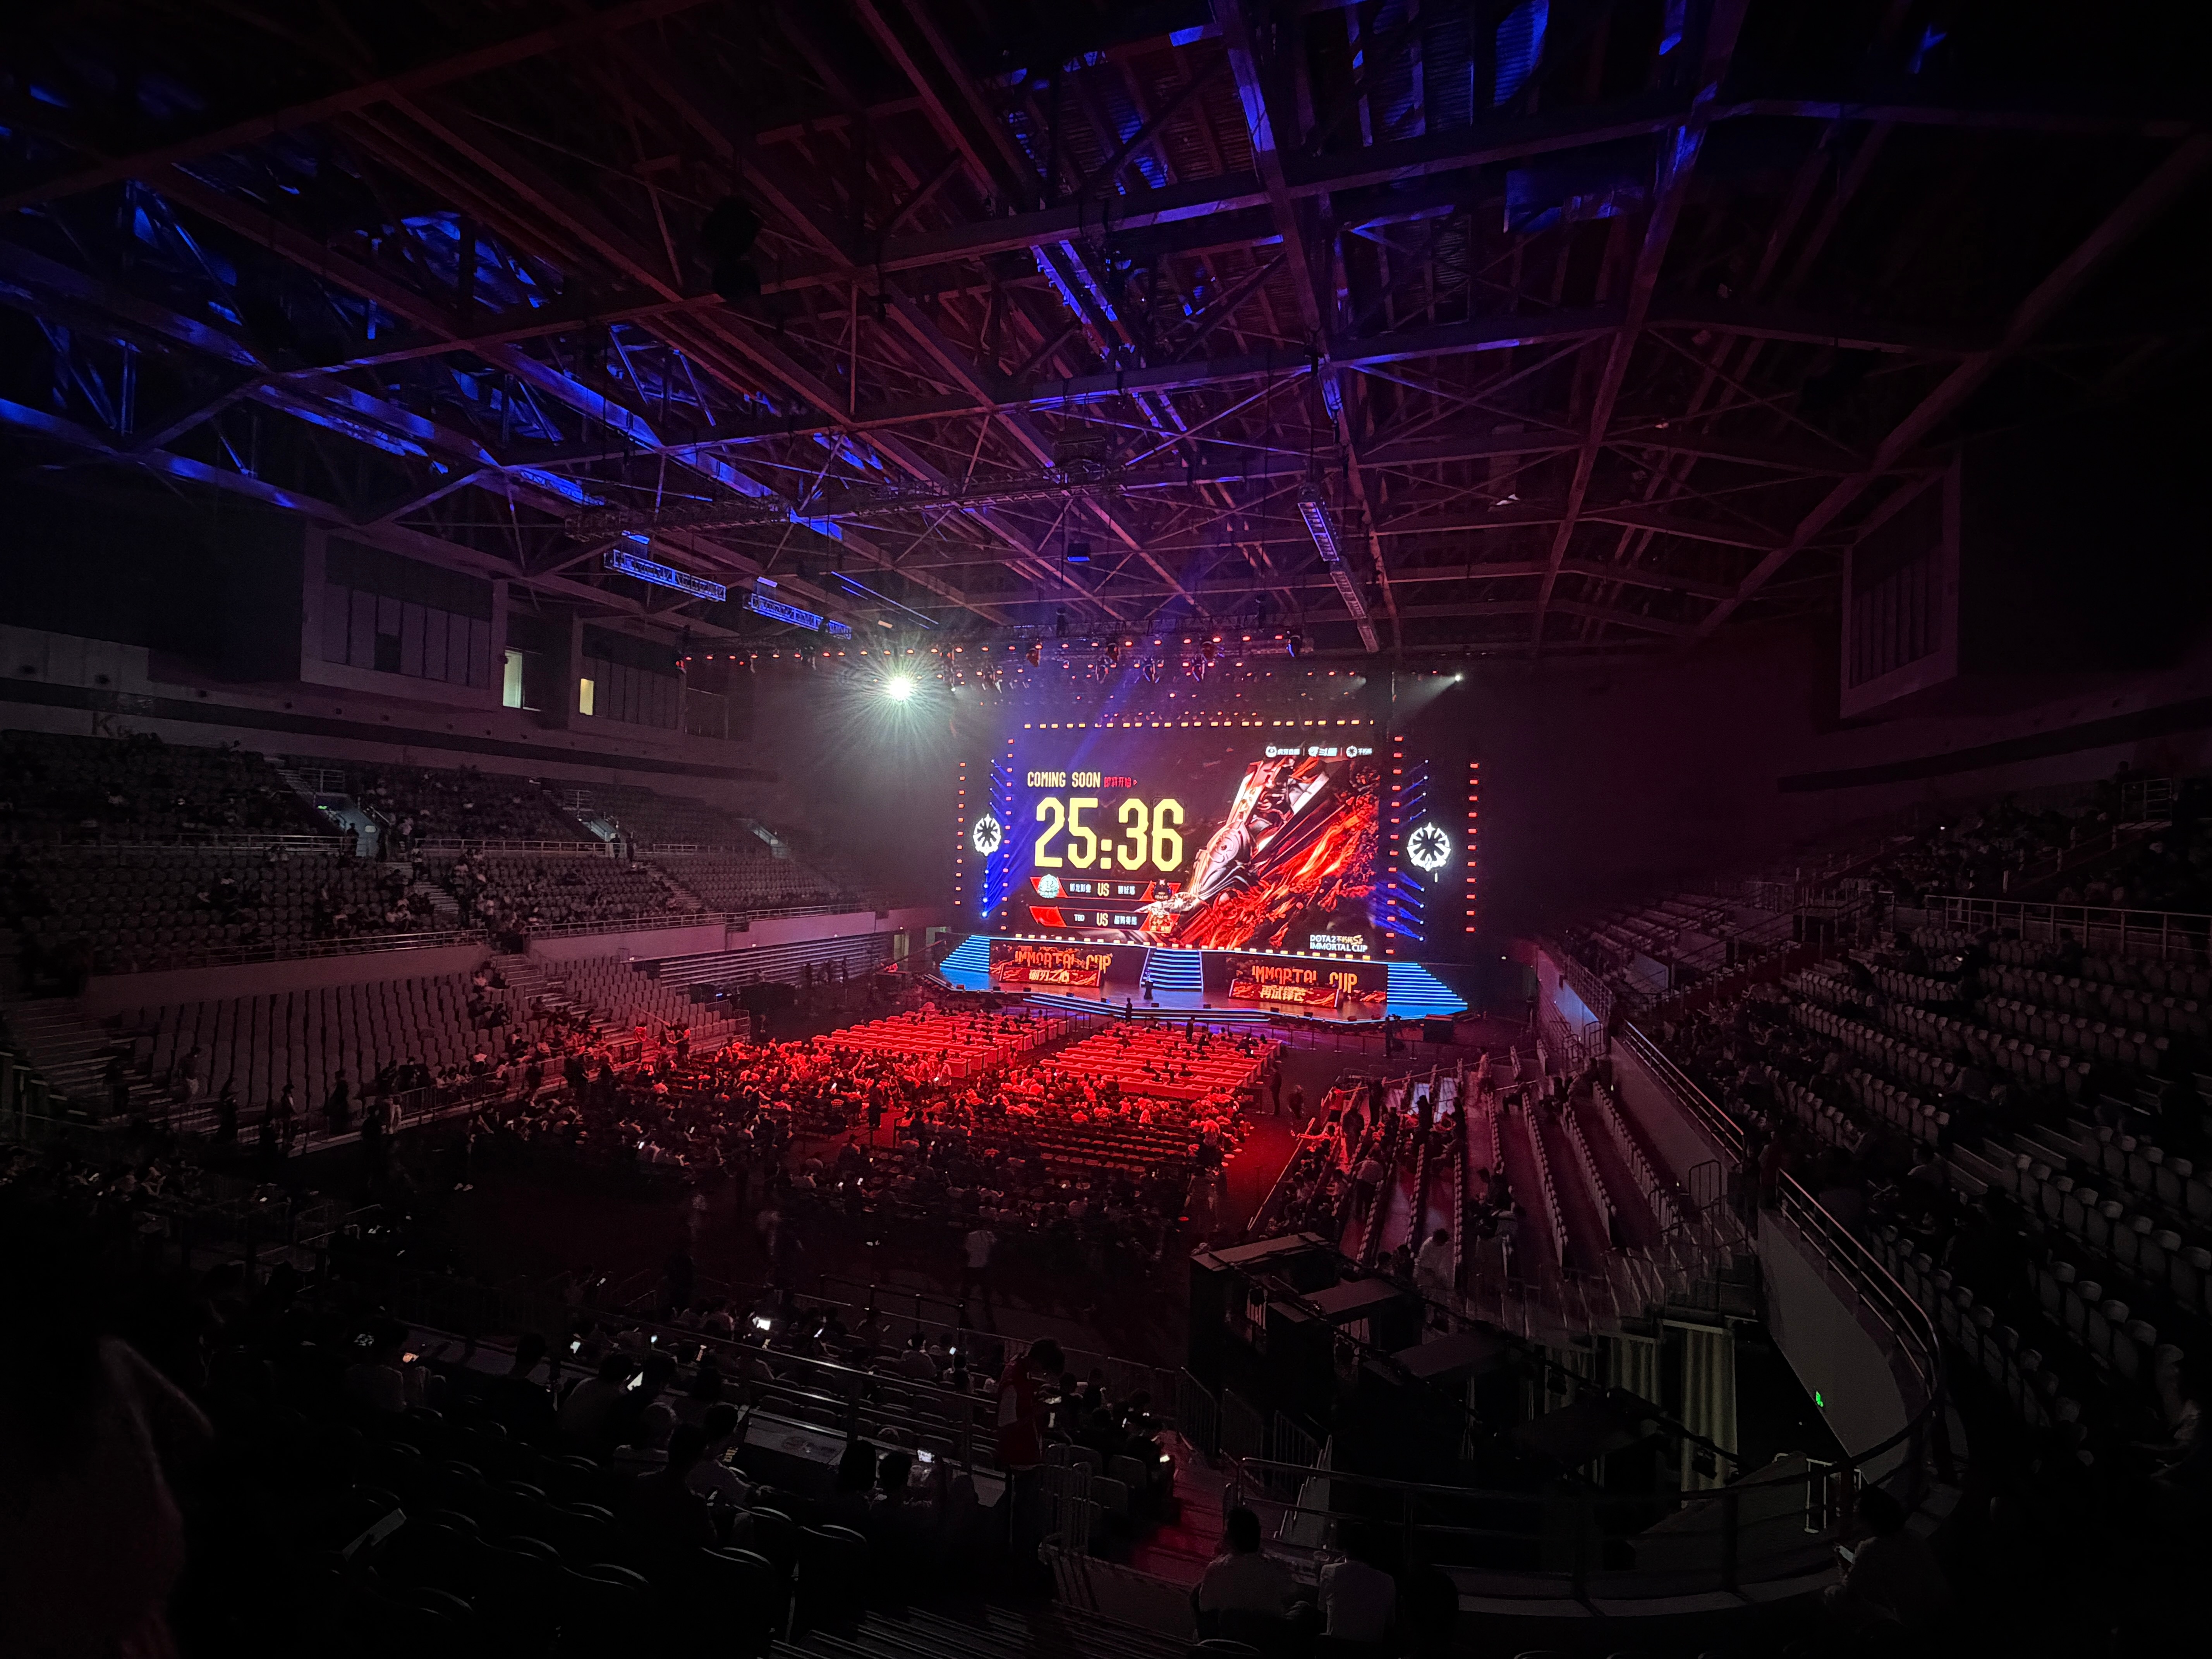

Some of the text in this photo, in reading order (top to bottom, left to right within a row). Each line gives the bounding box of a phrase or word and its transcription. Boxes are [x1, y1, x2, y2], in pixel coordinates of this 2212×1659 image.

[1027, 771, 1101, 788] COMING SOON
[1034, 797, 1184, 872] 25:36
[1309, 934, 1336, 943] DOTA2
[1309, 942, 1368, 953] IMMORTAL CUP
